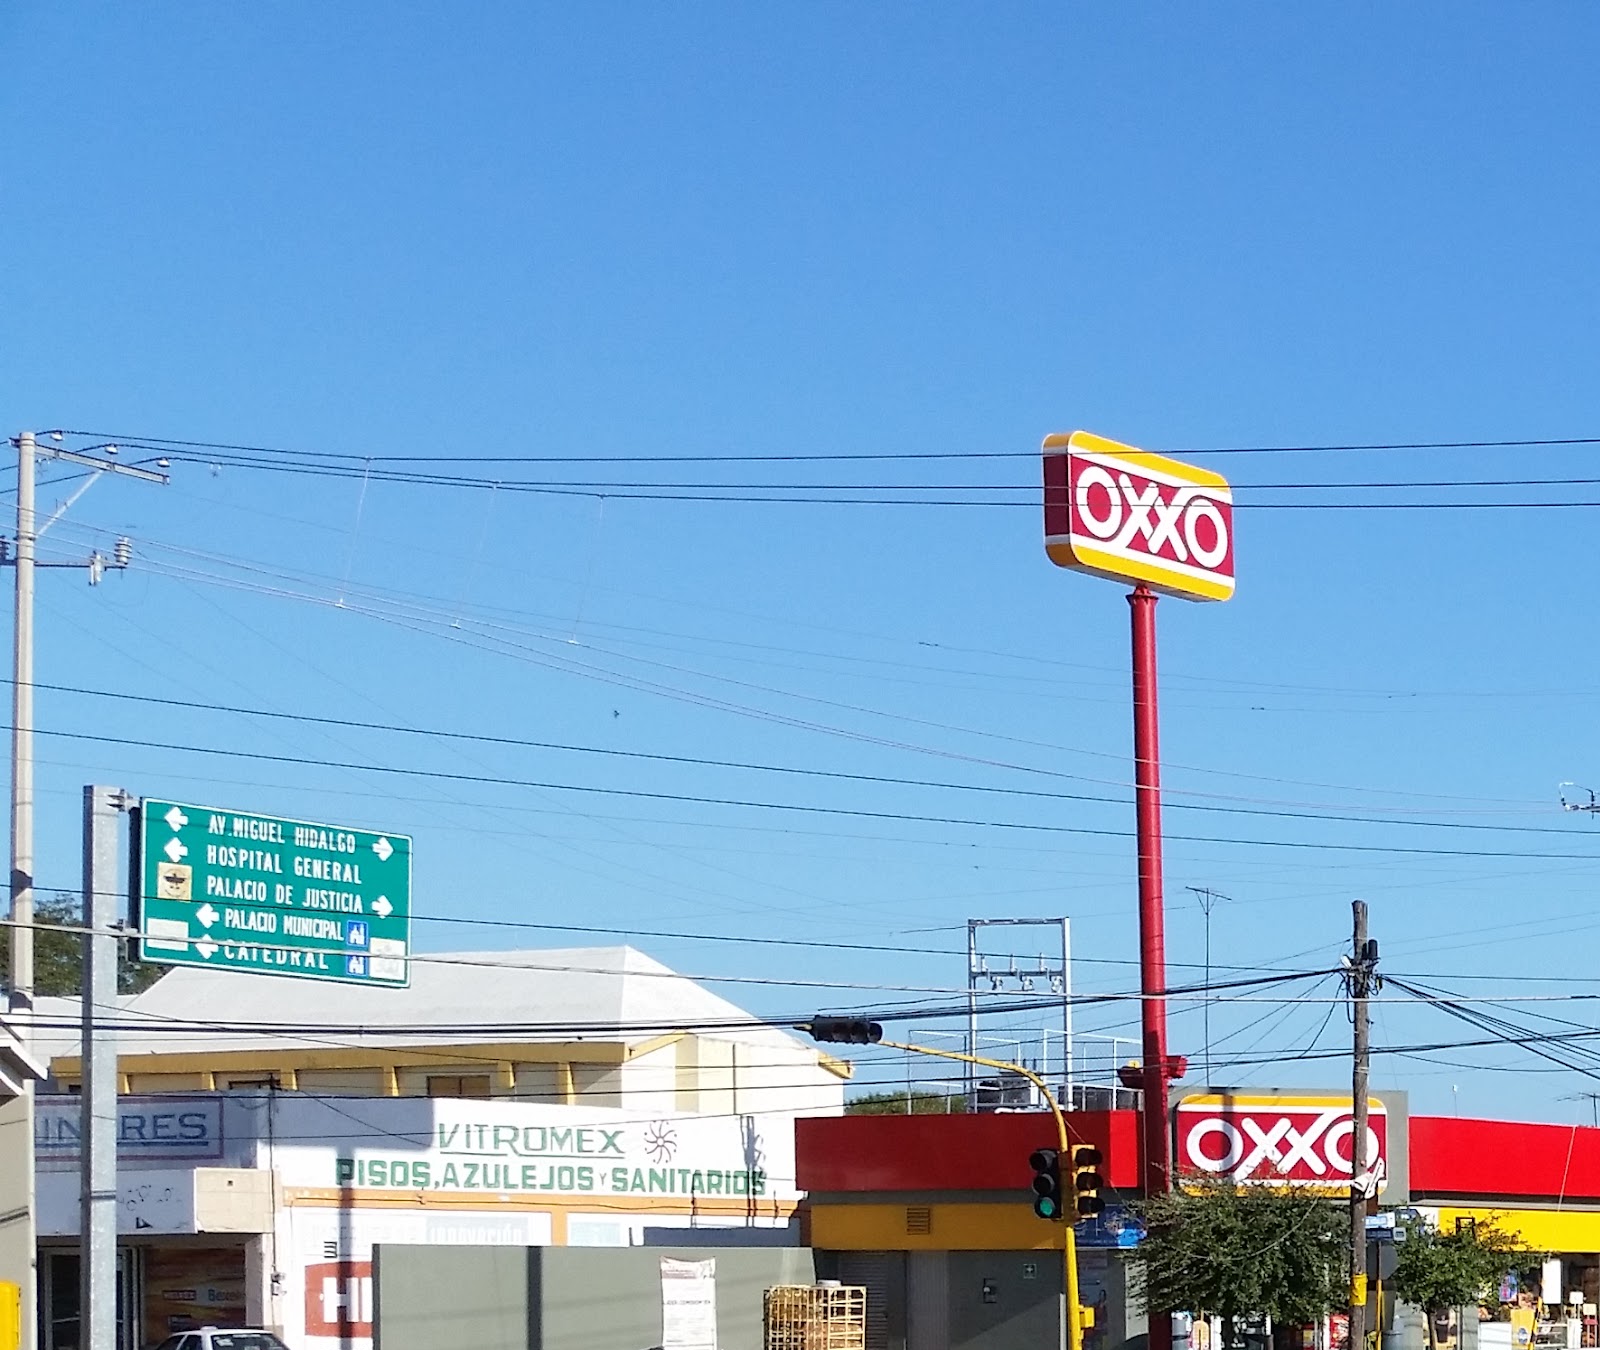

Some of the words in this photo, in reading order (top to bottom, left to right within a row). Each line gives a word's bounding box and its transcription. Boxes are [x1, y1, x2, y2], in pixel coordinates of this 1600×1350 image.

[1076, 465, 1228, 568] OXXO
[295, 826, 356, 854] HIDALGO
[207, 844, 283, 874] HOSPITAL
[294, 856, 362, 885] GENERAL
[207, 874, 267, 903] PALACIO
[275, 883, 294, 906] DE
[303, 887, 363, 914] JUSTICIA
[224, 908, 276, 934] PALACIO
[284, 915, 344, 942] MUNICIPAL
[223, 939, 329, 970] CATEDRAL
[35, 1113, 208, 1140] INRES
[438, 1123, 626, 1155] VITROMEX
[1186, 1115, 1380, 1181] OXXO
[612, 1167, 766, 1195] SANITARIOS
